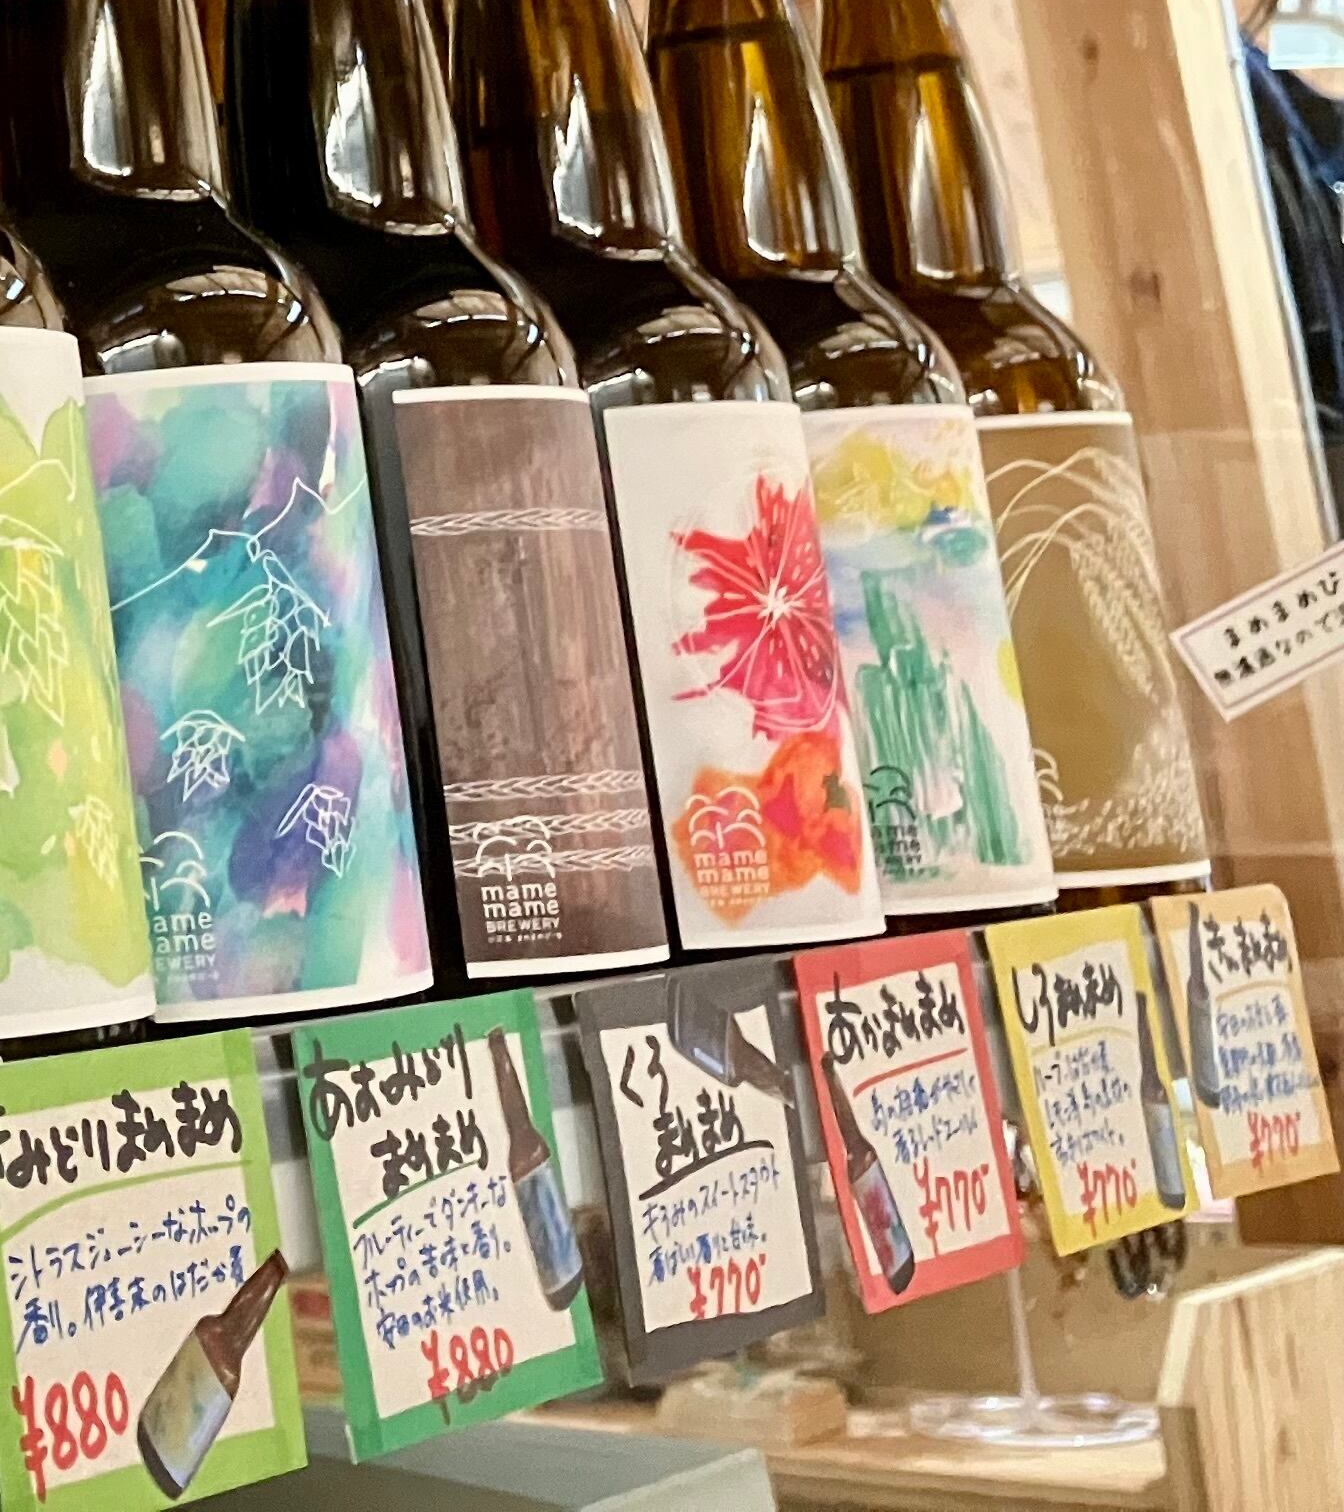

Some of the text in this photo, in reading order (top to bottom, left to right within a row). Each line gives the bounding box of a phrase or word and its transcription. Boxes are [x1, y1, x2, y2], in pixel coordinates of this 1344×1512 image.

[481, 882, 557, 903] mame
[483, 899, 560, 918] mame
[153, 911, 213, 934] ame
[156, 933, 216, 954] ame
[486, 917, 560, 934] BREWERY
[912, 1155, 990, 1257] ¥770
[1076, 1159, 1138, 1240] ¥770
[686, 1254, 767, 1320] ¥770
[421, 1325, 515, 1426] ¥880
[11, 1370, 129, 1503] ¥880
